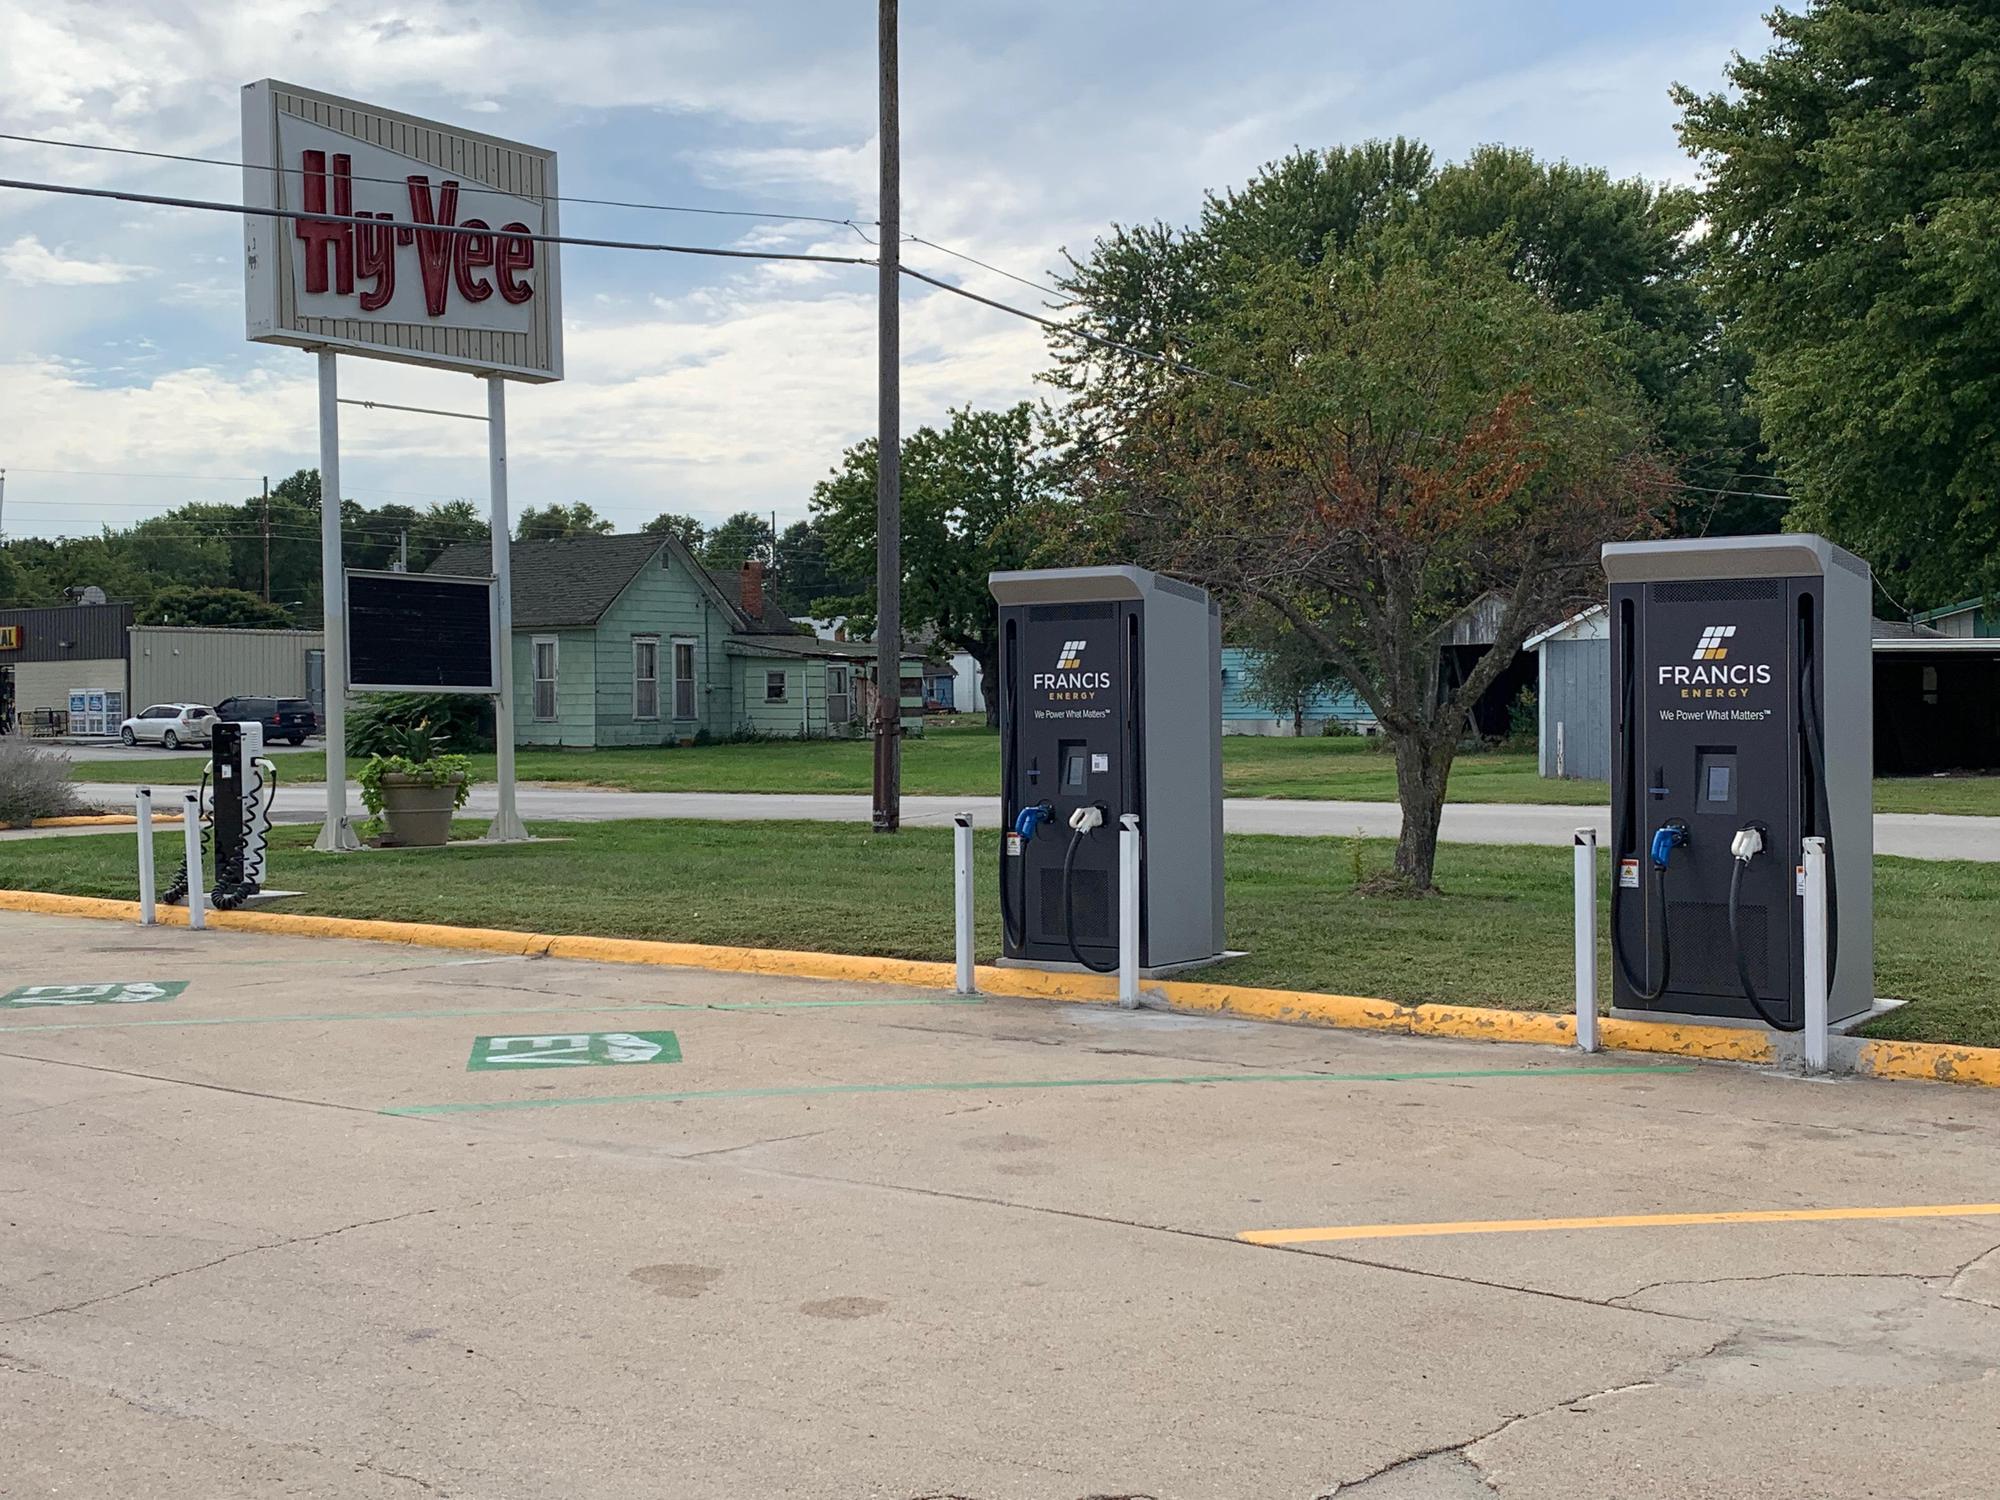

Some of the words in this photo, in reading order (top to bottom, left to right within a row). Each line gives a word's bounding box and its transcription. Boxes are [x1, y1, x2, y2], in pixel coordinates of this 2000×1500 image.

[296, 149, 534, 316] Hy-Vee
[1659, 665, 1771, 684] FRANCIS
[1034, 673, 1110, 689] FRANCIS
[1049, 691, 1095, 700] ENERGY
[1681, 688, 1749, 698] ENERGY
[1034, 710, 1045, 719] We
[1046, 710, 1065, 719] Power
[1066, 709, 1081, 718] What
[1660, 710, 1674, 720] We
[1676, 710, 1704, 720] Power
[1706, 710, 1729, 720] What
